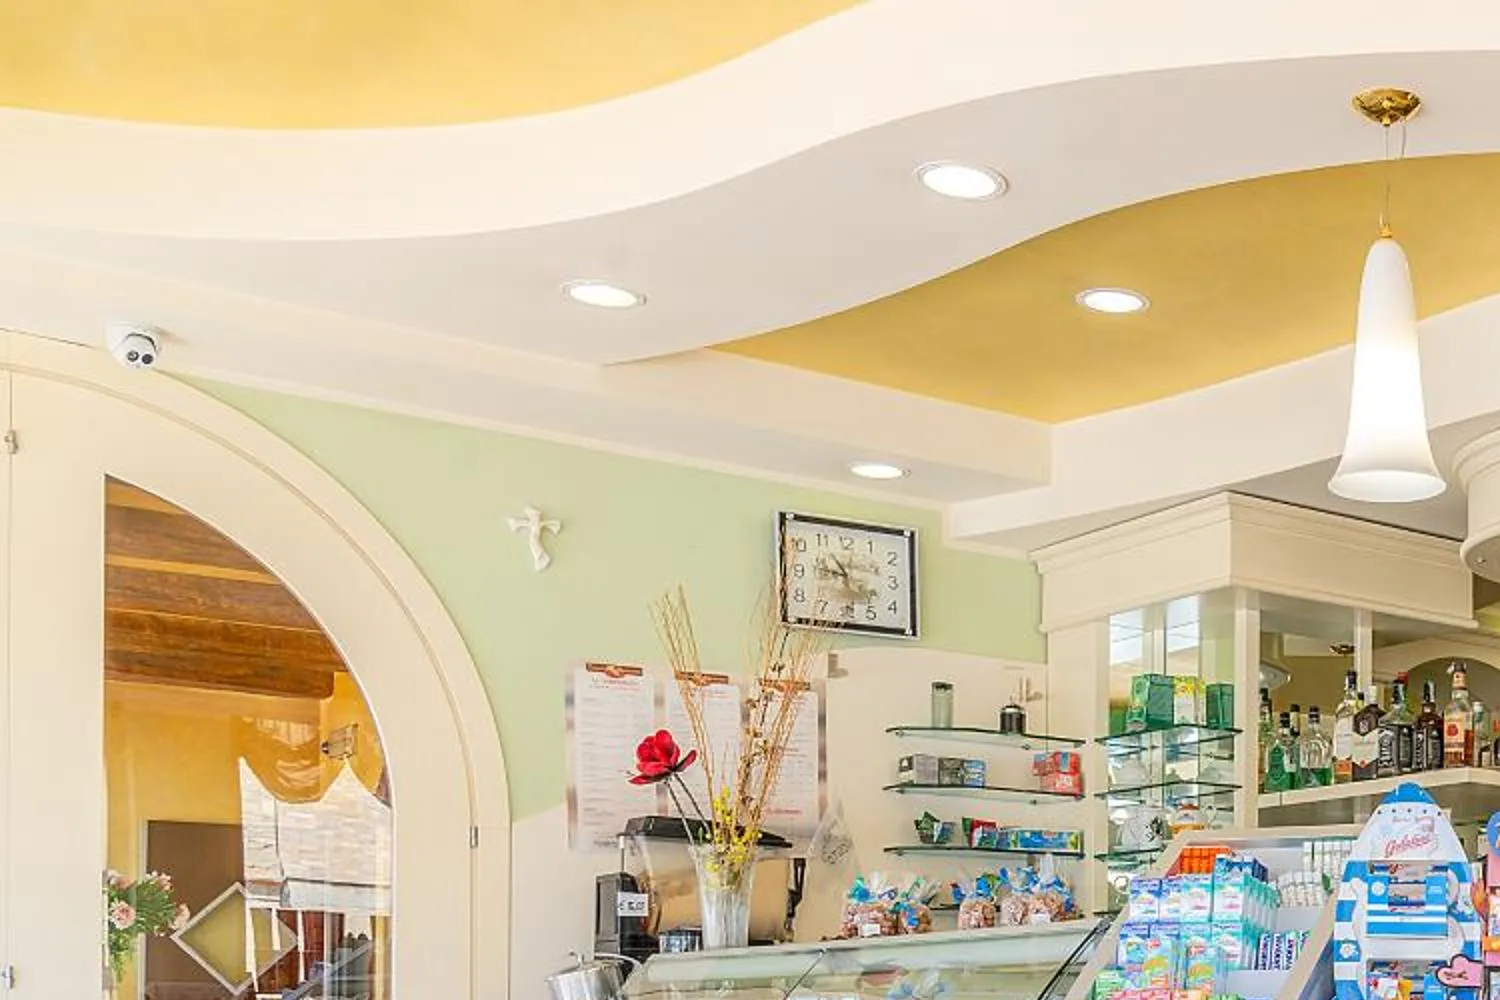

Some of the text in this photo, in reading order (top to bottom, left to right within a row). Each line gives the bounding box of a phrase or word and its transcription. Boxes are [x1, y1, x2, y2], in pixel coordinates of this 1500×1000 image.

[816, 533, 829, 547] 11
[867, 541, 874, 554] 1
[887, 551, 898, 566] 2
[793, 563, 805, 578] 9
[887, 575, 899, 590] 3
[793, 588, 805, 602] 8
[818, 600, 829, 614] 7
[865, 605, 877, 620] 5
[887, 600, 897, 614] 4
